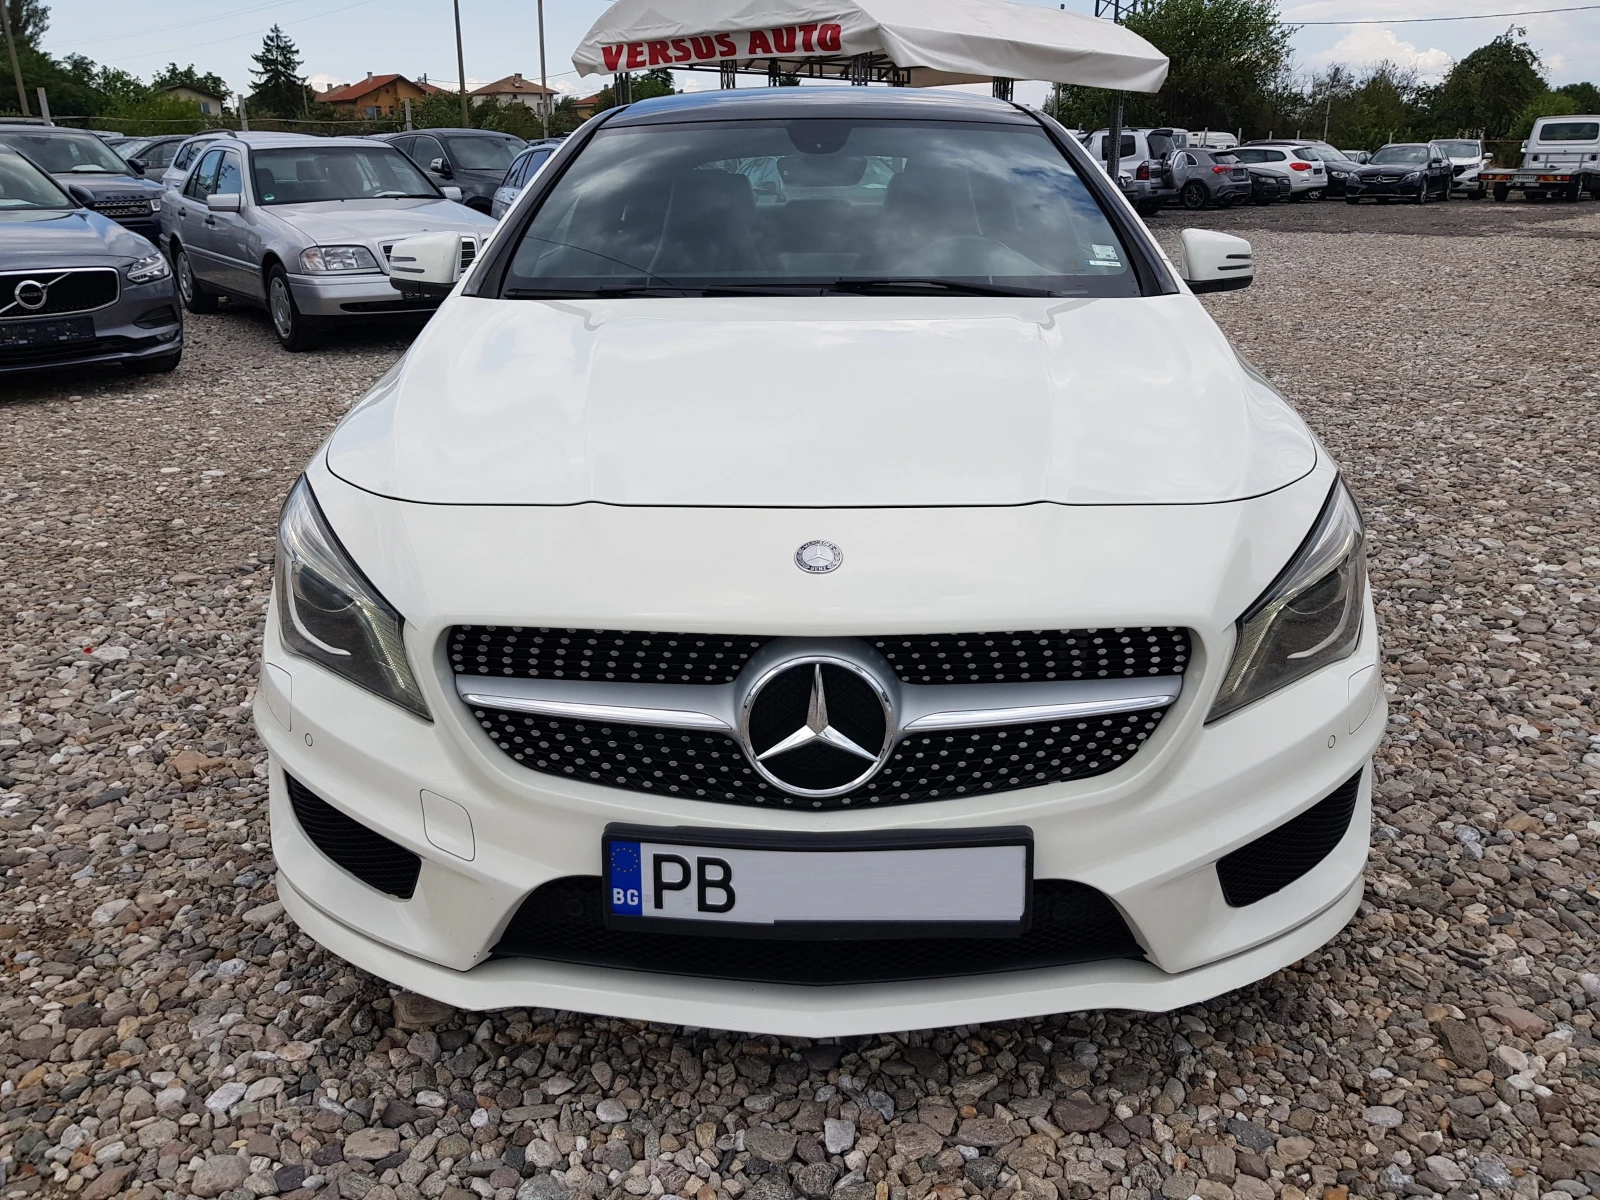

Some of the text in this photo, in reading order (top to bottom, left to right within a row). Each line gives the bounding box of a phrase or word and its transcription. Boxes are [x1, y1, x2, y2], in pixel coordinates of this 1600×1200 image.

[601, 23, 842, 71] VERSUS AUTO
[613, 888, 639, 906] BG
[653, 853, 736, 913] PB
